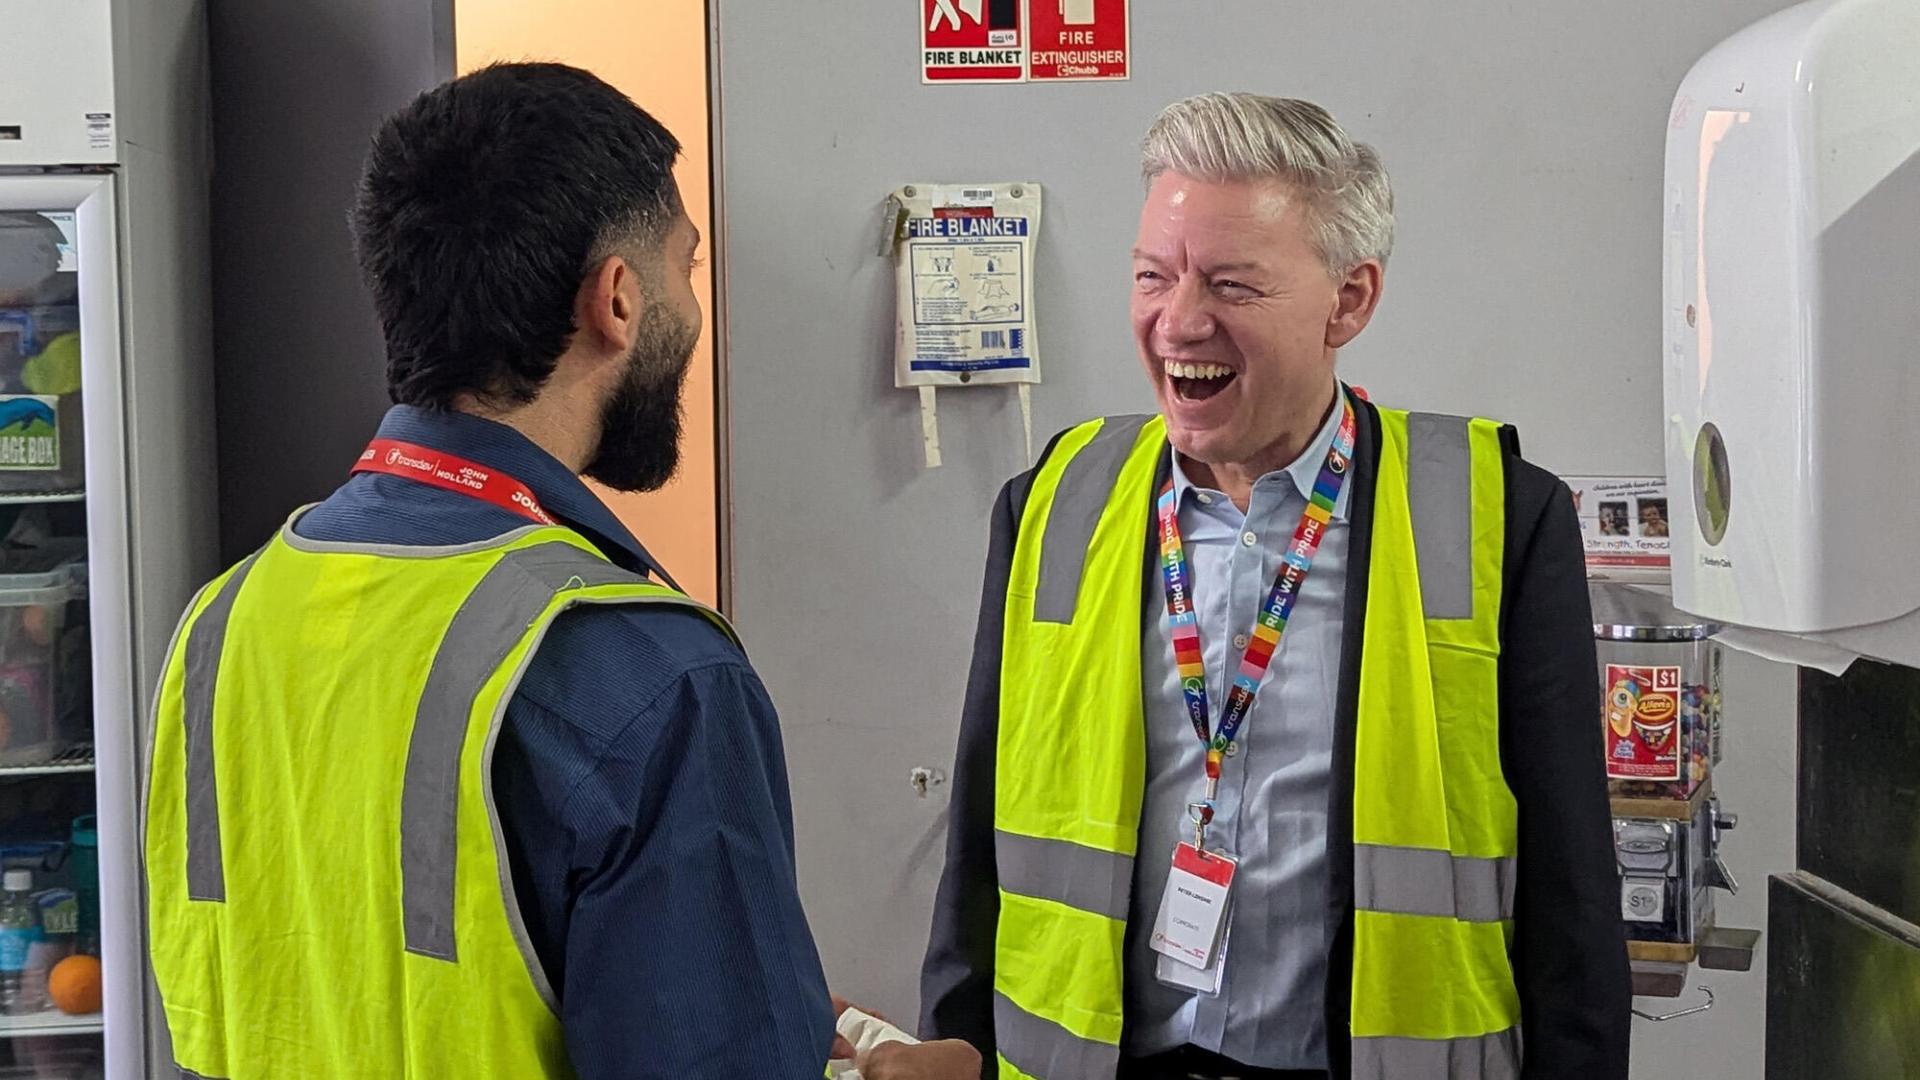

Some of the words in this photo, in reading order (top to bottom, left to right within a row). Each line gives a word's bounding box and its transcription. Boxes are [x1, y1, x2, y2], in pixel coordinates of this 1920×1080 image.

[1059, 31, 1094, 45] FIRE
[925, 51, 954, 65] FIRE
[959, 50, 1022, 65] BLANKET
[1031, 51, 1124, 66] EXTINGUISHER
[1069, 65, 1099, 75] Chubb
[948, 217, 1023, 237] BLANKET
[28, 436, 55, 464] BOX
[436, 471, 484, 489] HOLLAND
[459, 467, 489, 481] JOHN
[1166, 550, 1182, 584] WITH
[1265, 593, 1287, 628] RIDE
[1279, 559, 1303, 595] WITH
[1295, 521, 1320, 558] PRIDE
[1171, 584, 1187, 623] PRIDE
[1660, 670, 1676, 686] $1
[1224, 680, 1251, 730] transdev
